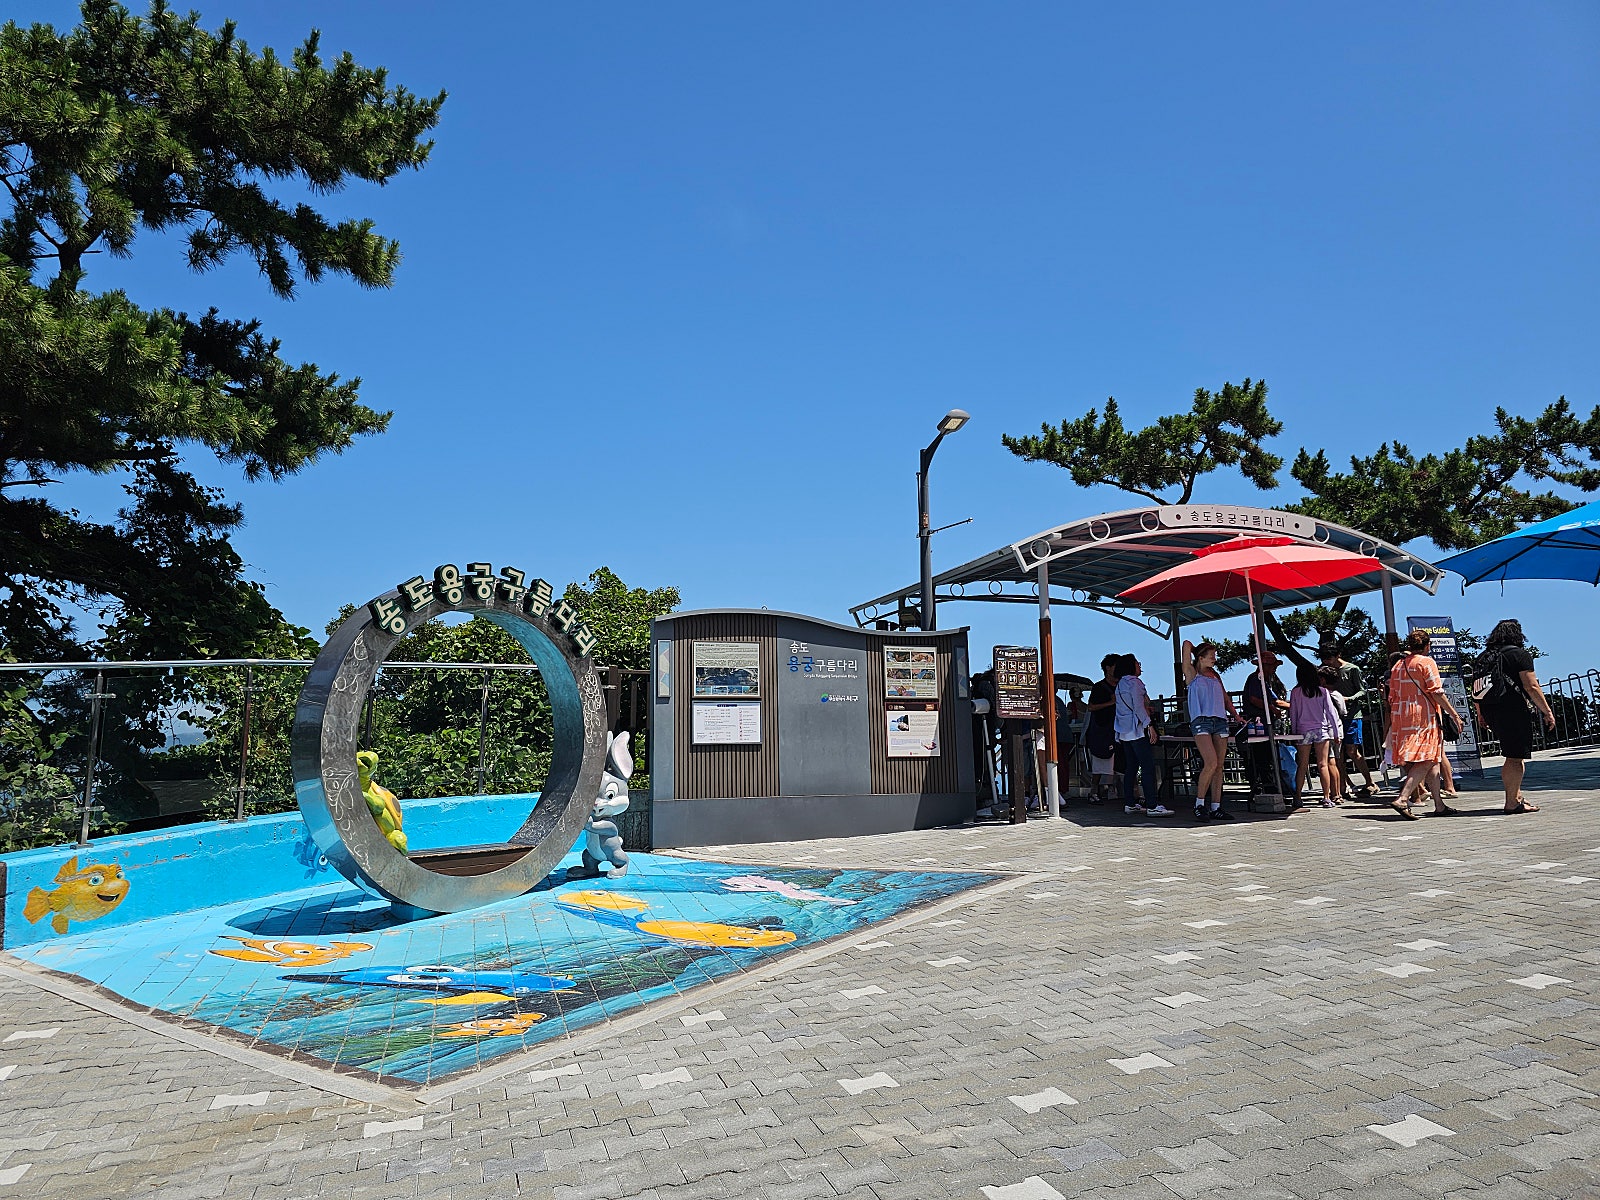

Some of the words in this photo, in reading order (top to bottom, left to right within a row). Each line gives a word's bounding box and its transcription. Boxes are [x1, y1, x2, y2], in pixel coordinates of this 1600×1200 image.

[371, 562, 598, 658] 송도용궁구름다리
[1432, 626, 1450, 634] Guide
[789, 640, 809, 654] 송도
[1473, 674, 1492, 694] NIKE
